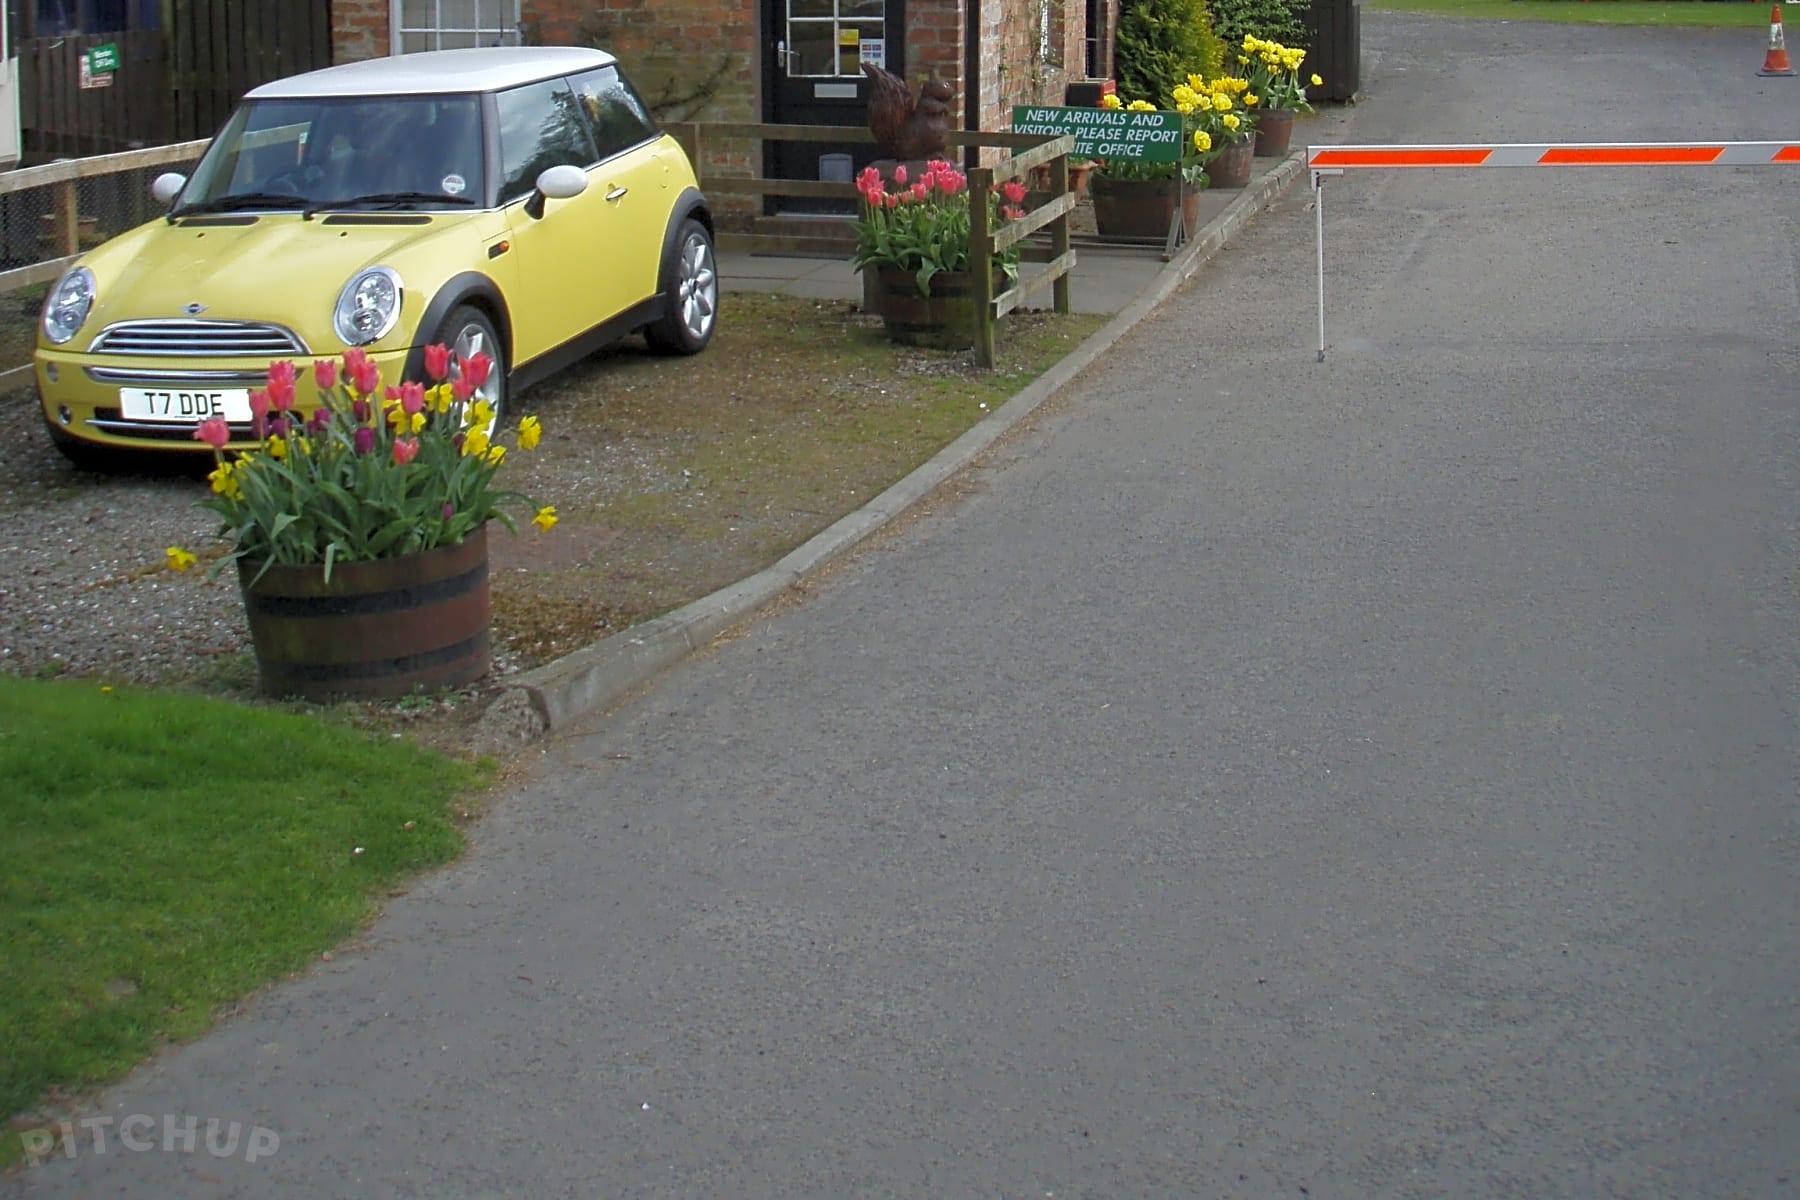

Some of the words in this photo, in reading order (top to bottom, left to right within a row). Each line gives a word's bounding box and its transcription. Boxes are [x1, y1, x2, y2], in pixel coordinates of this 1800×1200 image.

[1026, 109, 1059, 122] NEW
[1062, 111, 1127, 126] ARRIVALS
[1131, 114, 1164, 127] AND
[1075, 127, 1122, 141] PLEASE
[1126, 129, 1178, 143] REPORT
[1074, 142, 1094, 155] ITE
[1098, 143, 1144, 157] OFFICE
[144, 392, 171, 415] T7
[179, 393, 225, 415] DDE
